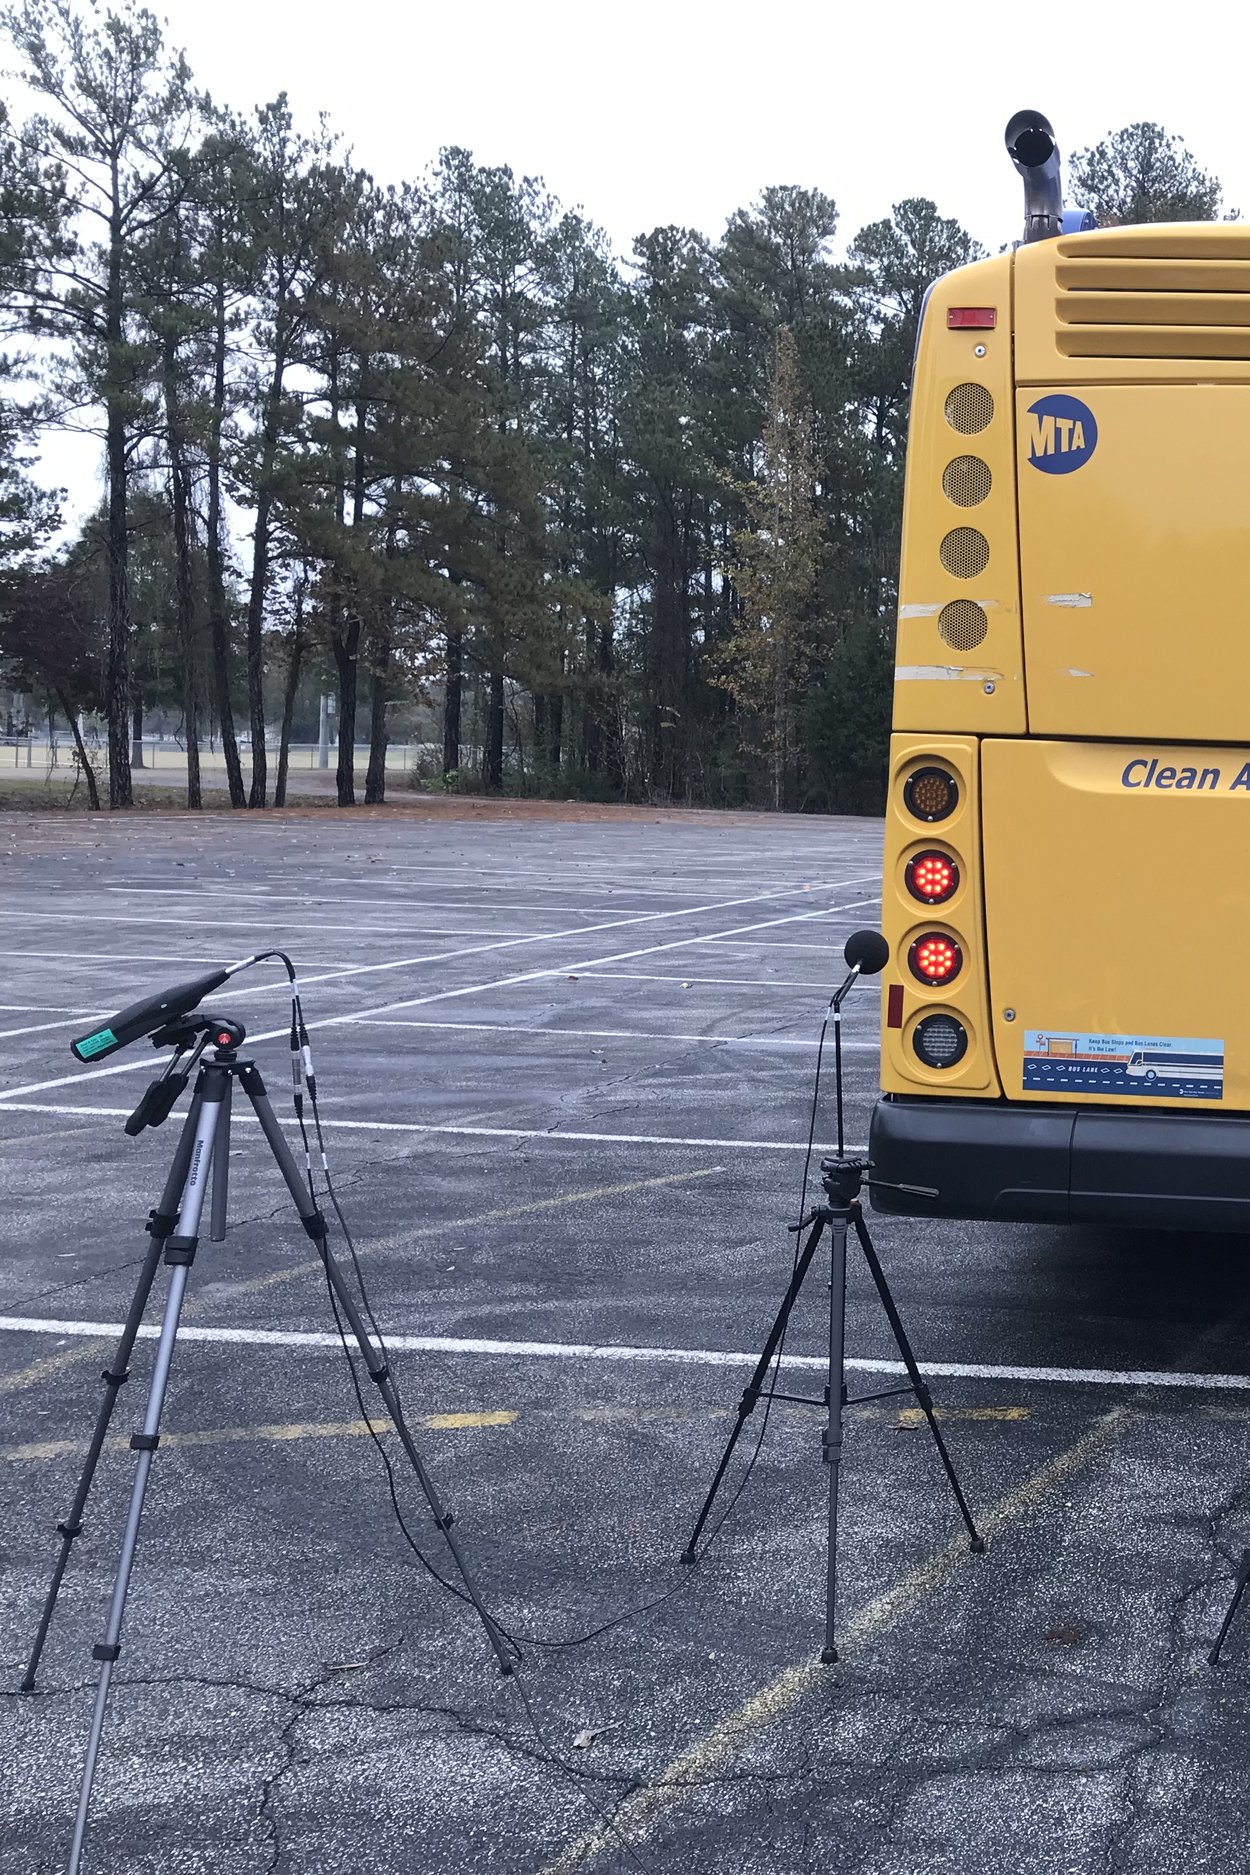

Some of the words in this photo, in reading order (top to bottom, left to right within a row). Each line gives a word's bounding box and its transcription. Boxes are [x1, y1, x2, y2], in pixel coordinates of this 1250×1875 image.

[1026, 411, 1086, 458] MTA
[1120, 758, 1220, 790] Clean
[190, 1140, 204, 1187] Manfrotto
